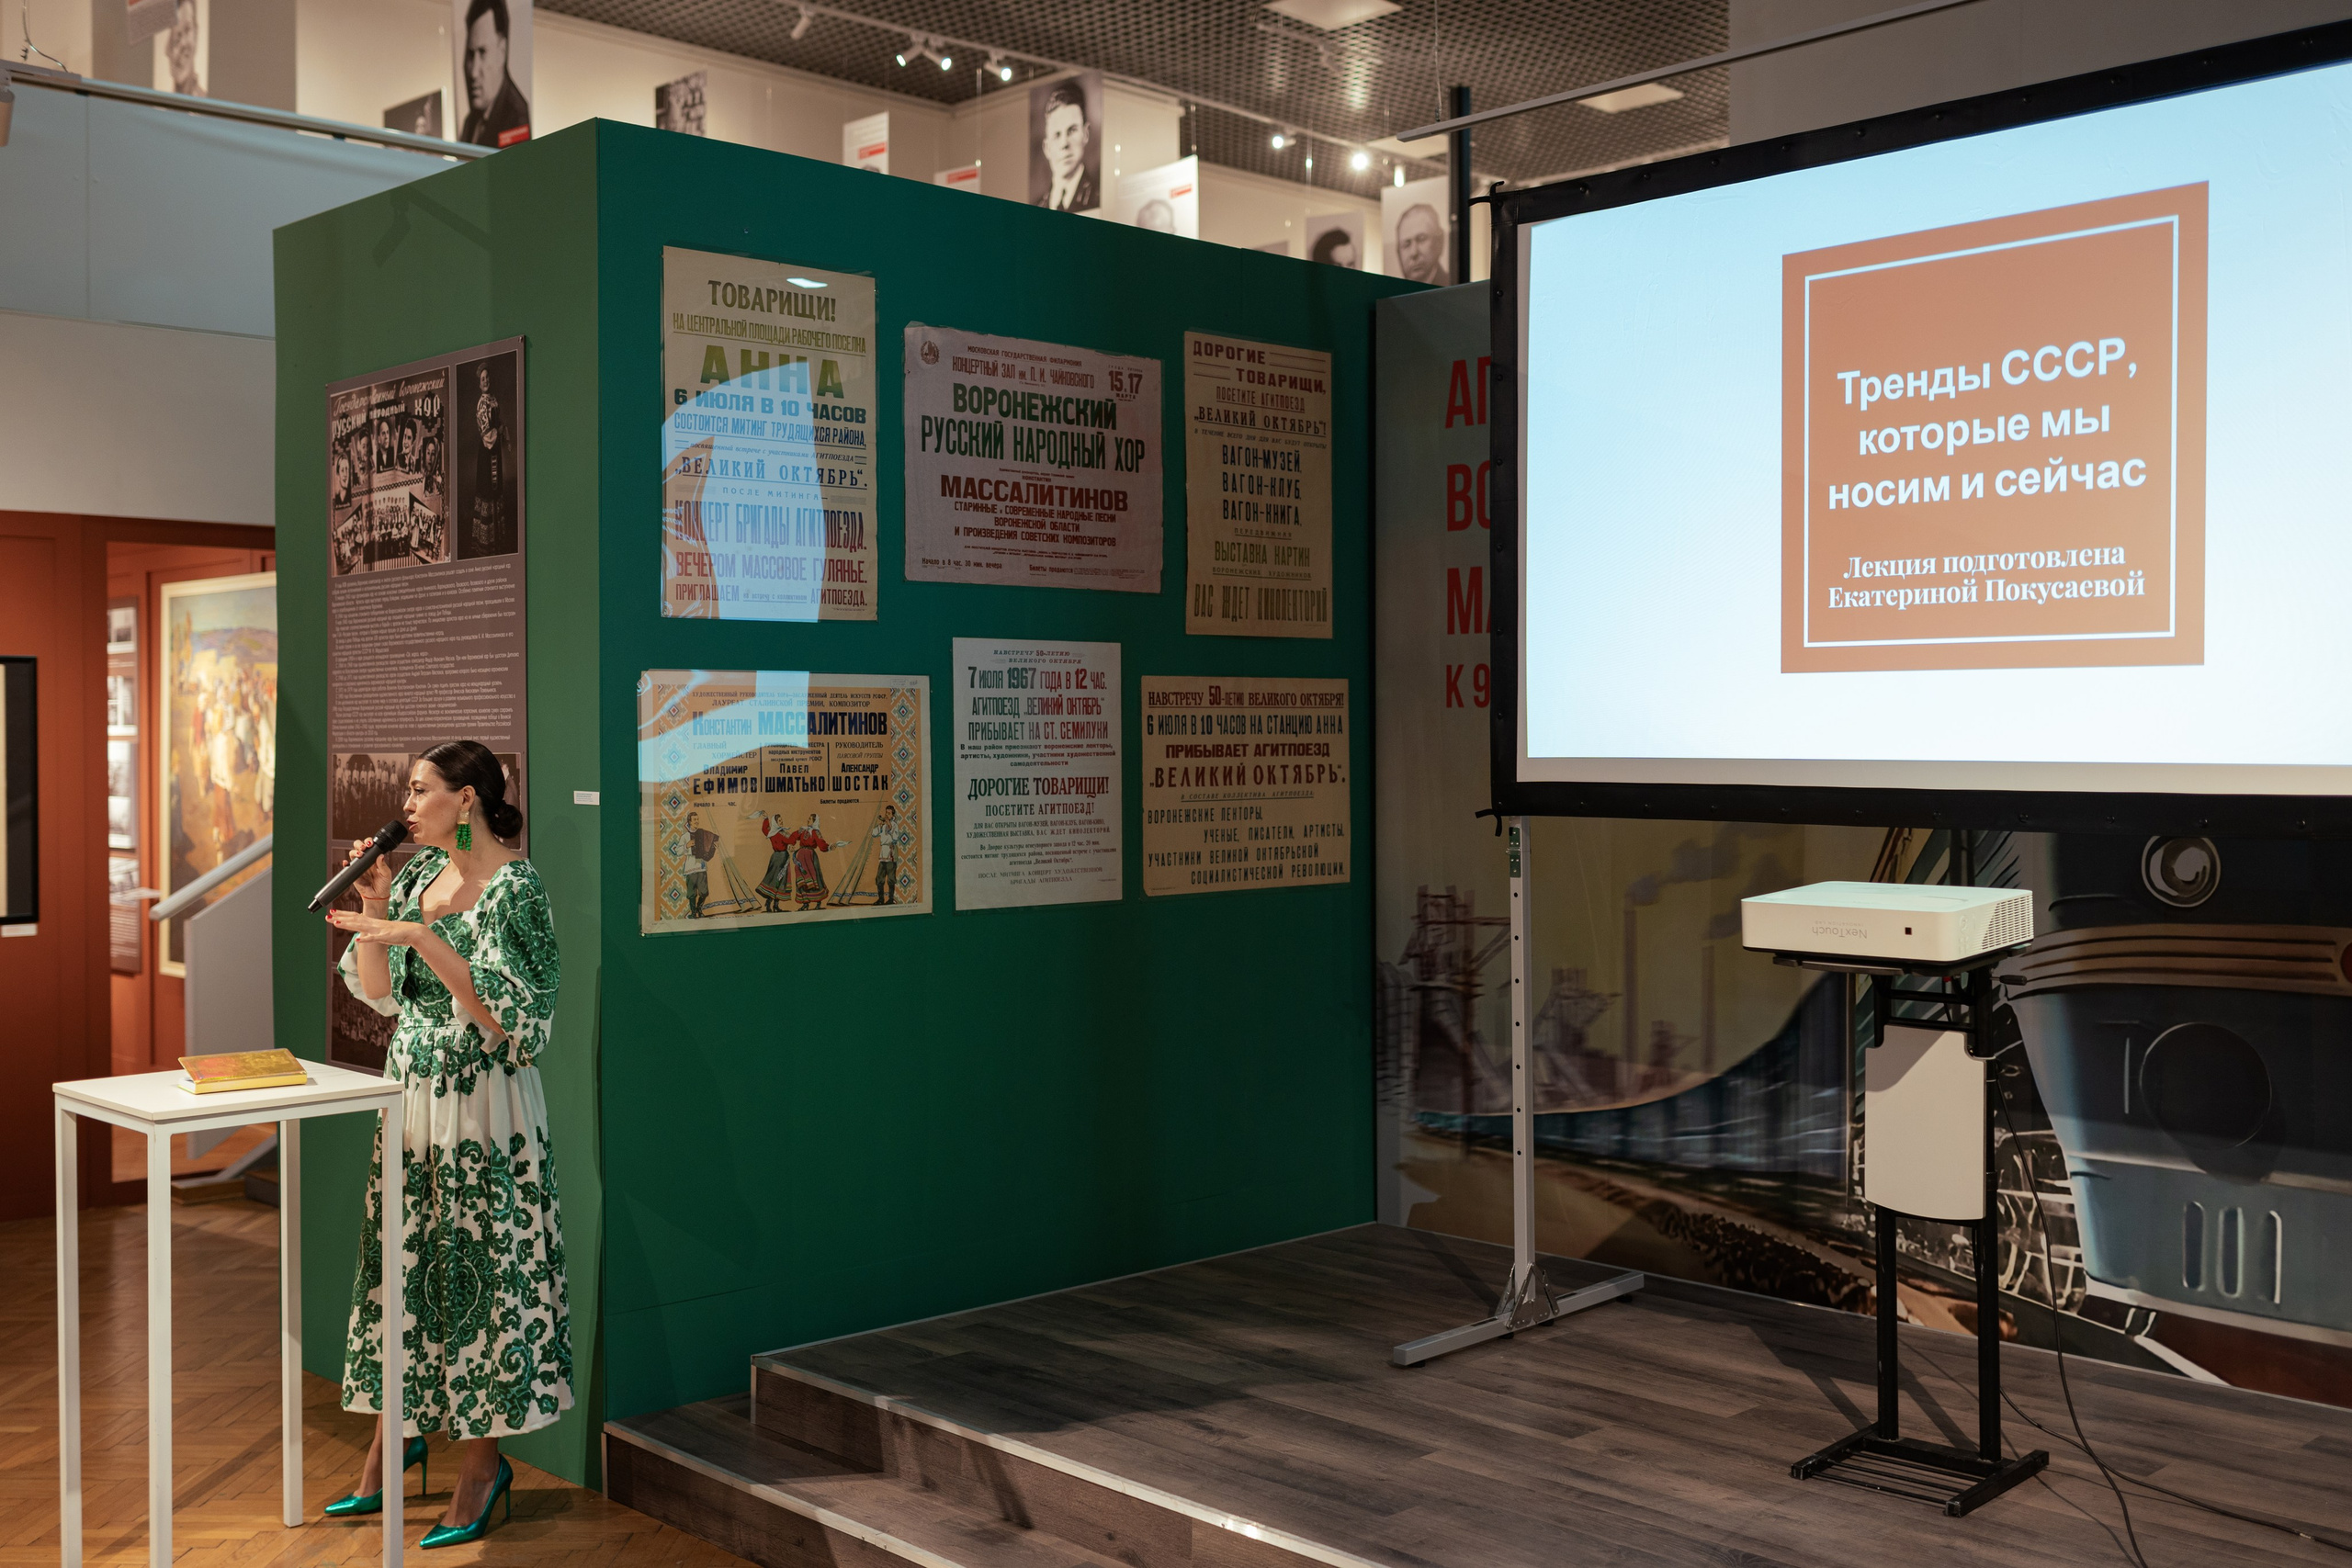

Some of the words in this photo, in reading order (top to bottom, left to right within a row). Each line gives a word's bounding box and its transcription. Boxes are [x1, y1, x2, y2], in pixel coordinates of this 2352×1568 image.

[708, 280, 836, 322] ТОВАРИЩИ!
[673, 313, 684, 330] НА
[687, 315, 747, 337] ЦЕНТРАЛЬНОЙ
[749, 322, 790, 344] ПЛОЩАДИ
[792, 328, 831, 348] РАБОЧЕГО
[832, 333, 866, 353] ПОСЕЛКА
[967, 345, 999, 355] МОСКОВСКАЯ
[1001, 350, 1046, 362] ГОСУДАРСТВЕННАЯ
[1193, 341, 1265, 364] ДОРОГИЕ
[700, 344, 844, 399] АННА
[952, 355, 998, 377] КОНЦЕРТНЫЙ
[1001, 364, 1015, 378] ЗАЛ
[1050, 368, 1094, 389] ЧАЙКОВСКОГО
[1109, 370, 1123, 391] 15
[1128, 373, 1142, 394] 17
[1236, 368, 1326, 395] ТОВАРИЩИ,
[1838, 363, 1991, 411] Тренды
[2001, 337, 2138, 385] СССР,
[674, 389, 687, 405] 6
[695, 390, 754, 412] ИЮЛЯ
[761, 398, 774, 413] В
[781, 400, 799, 416] 10
[807, 402, 866, 423] ЧАСОВ
[953, 383, 1116, 430] ВОРОНЕЖСКИЙ
[1216, 386, 1256, 404] ПОСЕТИТЕ
[1261, 392, 1305, 412] АГИТПОЕЗД
[674, 412, 729, 434] СОСТОИТСЯ
[731, 418, 766, 436] МИТИНГ
[772, 423, 831, 444] ТРУДЯЩИХСЯ
[1859, 412, 2030, 456] которые
[2041, 404, 2110, 438] мы
[922, 414, 1003, 460] РУССКИЙ
[1013, 426, 1105, 469] НАРОДНЫЙ
[1114, 437, 1145, 473] ХОР
[723, 487, 760, 496] ПОСЛЕ
[941, 475, 1128, 512] МАССАЛИТИНОВ
[1828, 473, 1950, 510] носим
[1962, 472, 1984, 500] и
[1995, 457, 2147, 497] сейчас
[675, 500, 729, 547] КОНЦЕРТ
[736, 503, 789, 548] БРИГАДЫ
[955, 502, 997, 513] СТАРИННЫЕ
[1004, 505, 1055, 519] СОВРЕМЕННЫЕ
[1057, 509, 1093, 522] НАРОДНЫЕ
[1095, 513, 1116, 523] ПЕСНИ
[994, 515, 1046, 530] ВОРОНЕЖСКОЙ
[1050, 522, 1080, 532] ОБЛАСТИ
[955, 526, 959, 536] И
[963, 527, 1017, 541] ПРОИЗВЕДЕНИЯ
[1021, 531, 1059, 543] СОВЕТСКИХ
[1063, 535, 1116, 547] КОМПОЗИТОРОВ
[1215, 541, 1267, 564] ВЫСТАВКА
[1274, 546, 1310, 567] КАРТИН
[1843, 556, 1937, 580] Лекция
[1943, 546, 2126, 577] подготовлена
[676, 551, 736, 578] ВЕЧЕРОМ
[741, 554, 807, 581] МАССОВОЕ
[813, 558, 867, 584] ГУЛЯНЬЕ.
[1213, 567, 1261, 575] ВОРОНЕЖСКИХ
[676, 584, 740, 602] ПРИГЛАШАЕМ
[1828, 578, 1979, 611] Екатериной
[1984, 570, 2145, 605] Покусаевой
[1194, 584, 1213, 617] ВАС
[1222, 585, 1250, 622] ЖДЕТ
[1258, 587, 1328, 622] КИНОЛЕКТОРИЙ
[968, 667, 977, 689] 7
[979, 670, 1002, 689] ИЮЛЯ
[1007, 667, 1036, 689] 1967
[1040, 671, 1061, 692] ГОДА
[1066, 671, 1070, 689] В
[1075, 669, 1087, 689] 12
[1091, 671, 1107, 690] ЧАС.
[1148, 692, 1204, 705] НАВСТРЕЧУ
[1209, 685, 1244, 705] 50-ЛЕТИЮ
[1249, 692, 1296, 705] ВЕЛИКОГО
[1300, 694, 1344, 705] ОКТЯБРЯ!
[972, 697, 1020, 718] АГИТПОЕЗД
[758, 711, 888, 735] МАССАЛИТИНОВ
[968, 722, 1024, 740] ПРИБЫВАЕТ
[1029, 722, 1040, 739] НА
[1044, 722, 1057, 739] СТ.
[1060, 721, 1108, 739] СЕМИЛУКИ
[1148, 715, 1153, 735] 6
[1159, 715, 1186, 735] ИЮЛЯ
[1192, 715, 1196, 735] В
[1201, 715, 1212, 735] 10
[1216, 715, 1246, 735] ЧАСОВ
[1250, 715, 1262, 735] НА
[1267, 715, 1312, 737] СТАНЦИЮ
[1317, 715, 1342, 734] АННА
[693, 741, 727, 750] ГЛАВНЫЙ
[1166, 744, 1249, 759] ПРИБЫВАЕТ
[1254, 743, 1330, 757] АГИТПОЕЗД
[694, 777, 757, 795] ЕФИМОВ
[765, 776, 825, 793] ШМАТЬКО
[832, 775, 888, 791] ШОСТАК
[967, 778, 1029, 800] ДОРОГИЕ
[1034, 777, 1109, 798] ТОВАРИЩИ!
[986, 805, 1035, 816] ПОСЕТИТЕ
[1038, 802, 1094, 815] АГИТПОЕЗД!
[1148, 808, 1215, 824] ВОРОНЕЖСКИЕ
[1148, 852, 1202, 867] УЧАСТНИКИ
[1210, 847, 1249, 863] ВЕЛИКОЙ
[1257, 843, 1318, 861] ОКТЯБРЬСКОЙ
[1192, 864, 1283, 885] СОЦИАЛИСТИЧЕСКОЙ
[1811, 926, 1868, 939] NexTouch
